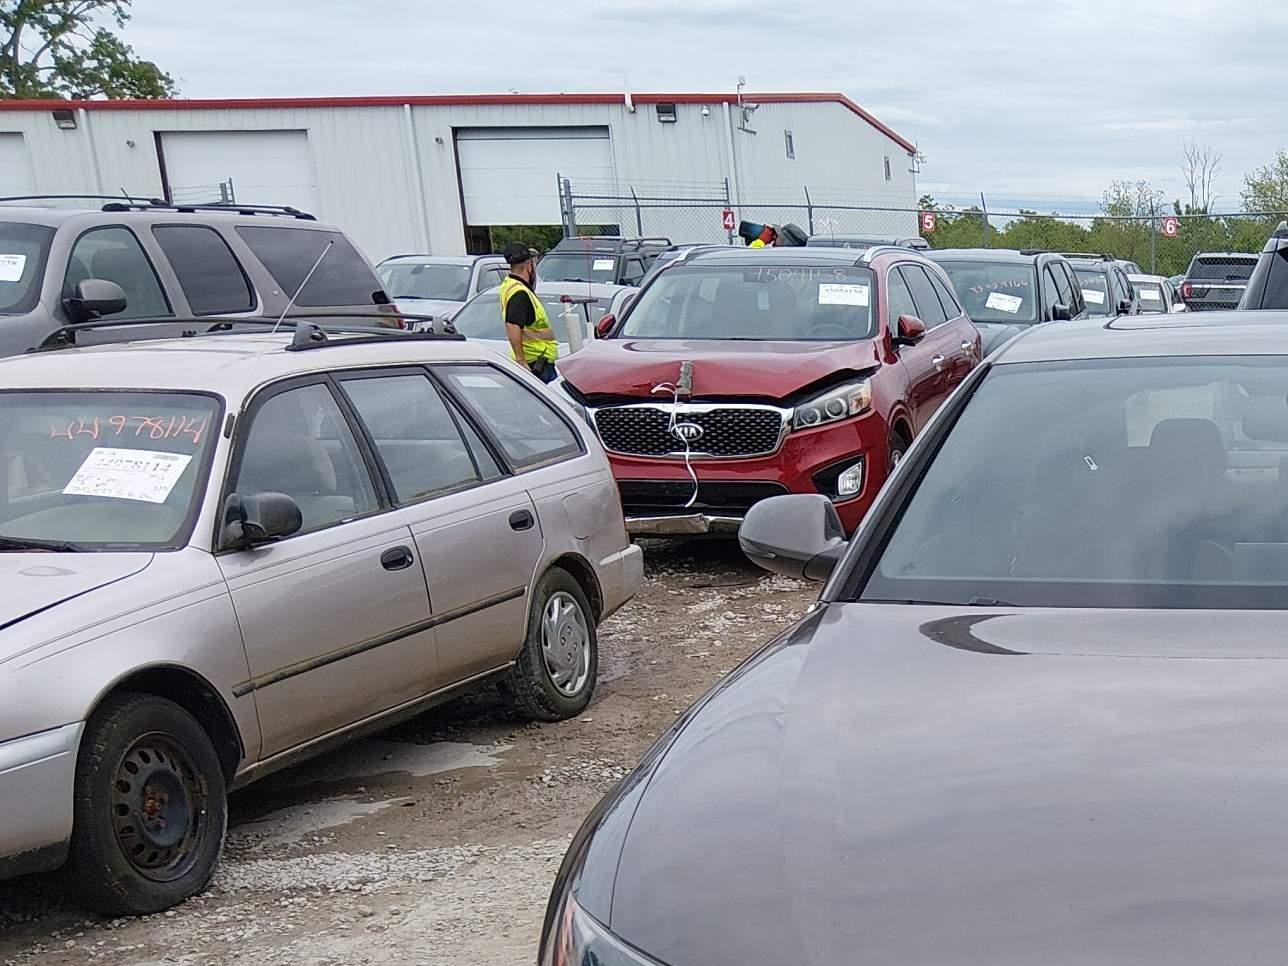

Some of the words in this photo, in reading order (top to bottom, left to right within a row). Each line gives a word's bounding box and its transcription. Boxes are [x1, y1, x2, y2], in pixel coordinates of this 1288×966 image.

[725, 213, 734, 228] 4
[924, 215, 934, 230] 5
[1166, 219, 1176, 235] 6
